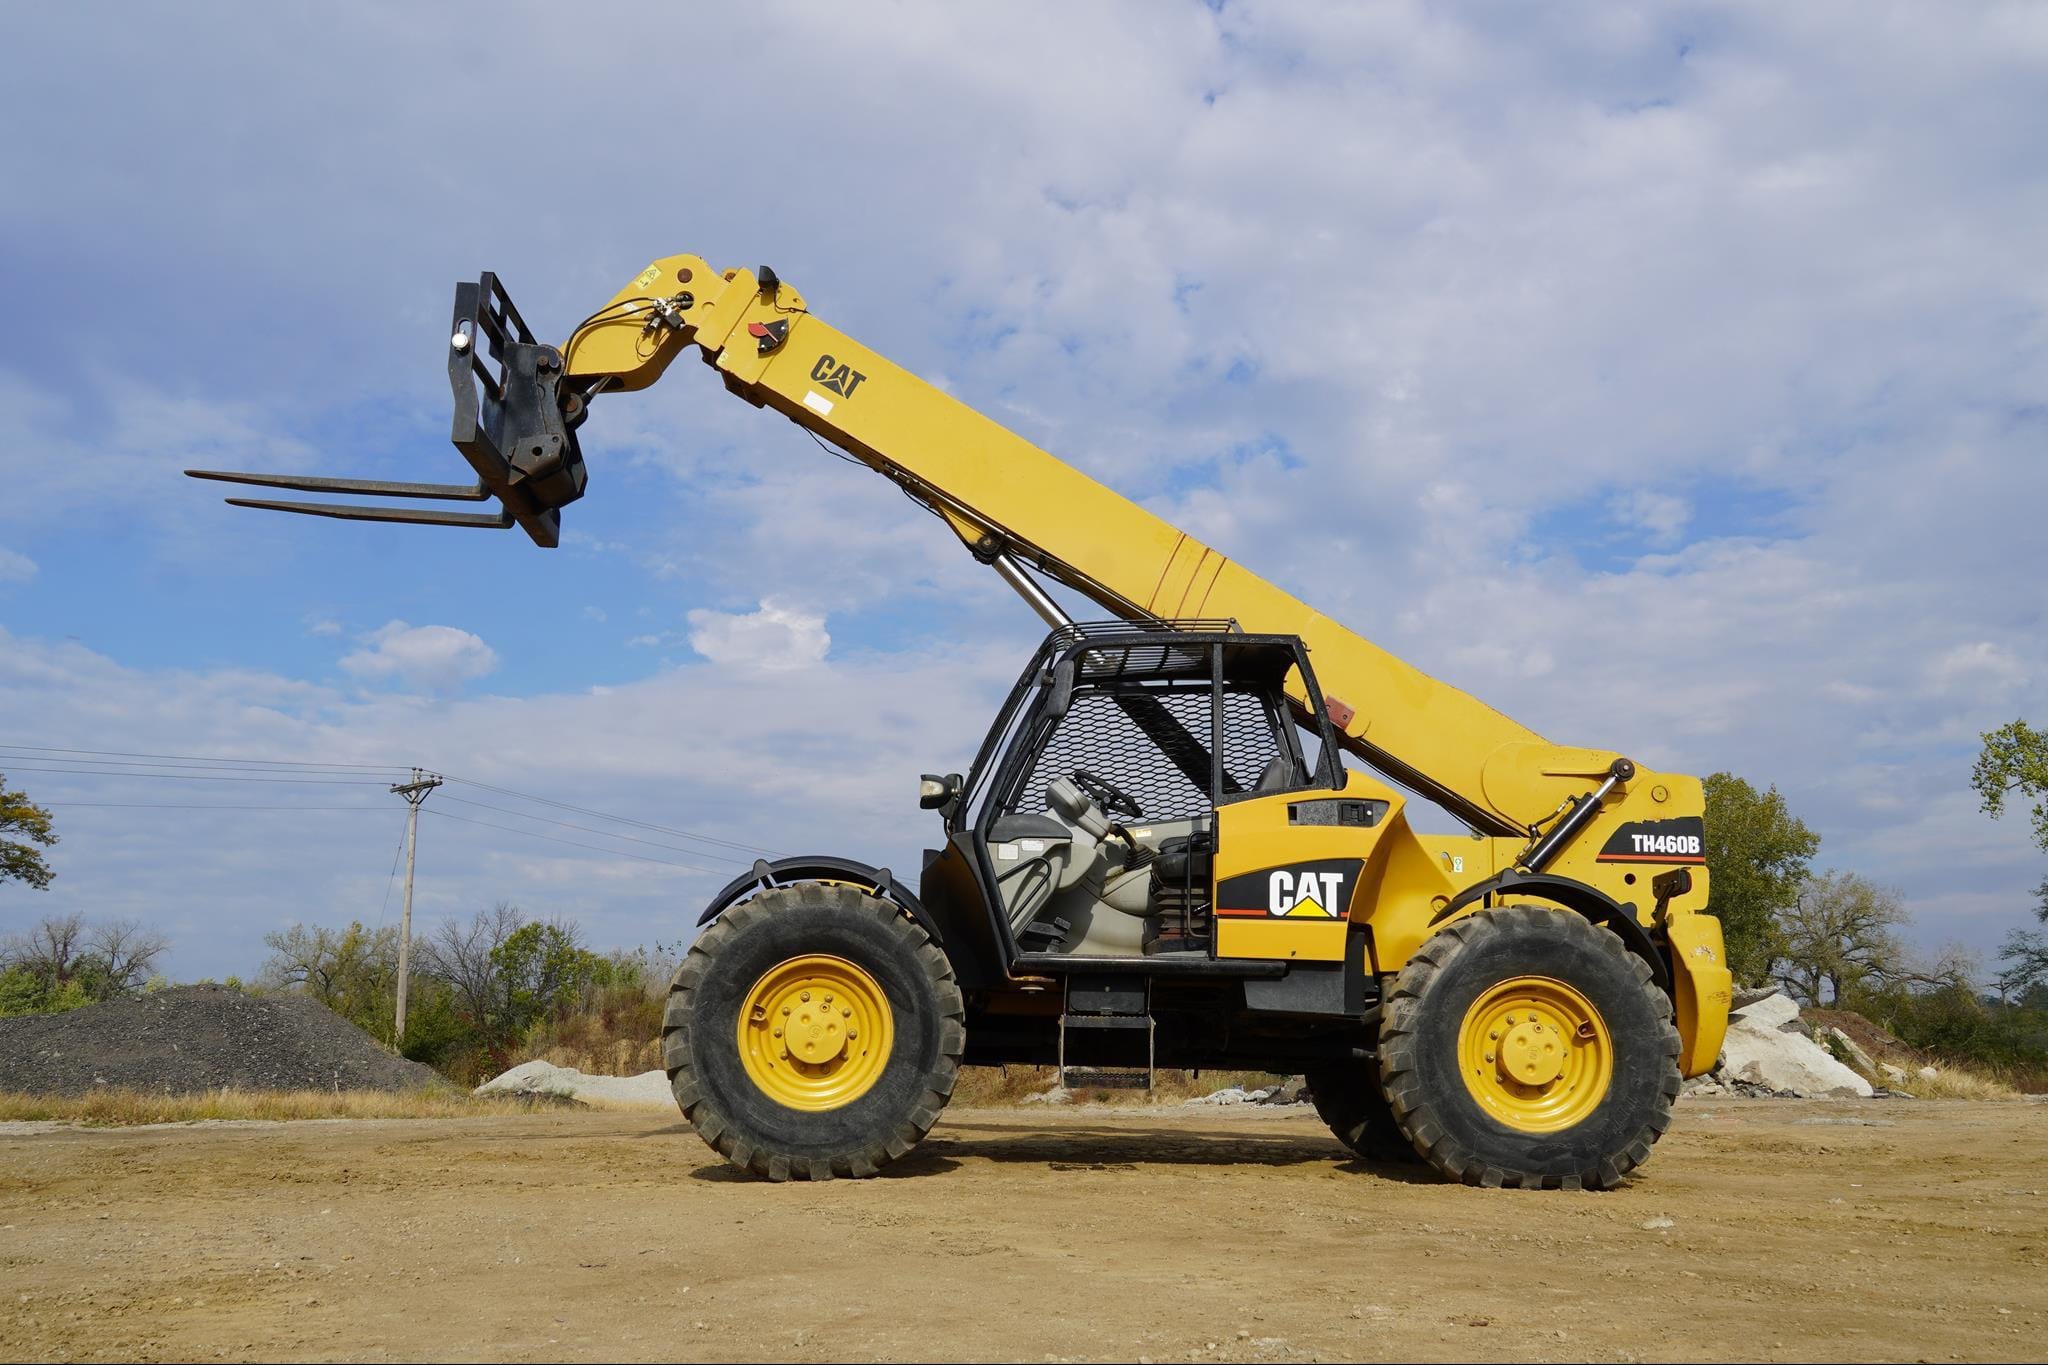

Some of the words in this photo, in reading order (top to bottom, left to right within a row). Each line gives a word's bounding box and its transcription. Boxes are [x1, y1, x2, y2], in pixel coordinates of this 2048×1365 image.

[811, 355, 867, 399] CAT
[1632, 834, 1700, 854] TH460B
[1270, 870, 1343, 917] CAT
